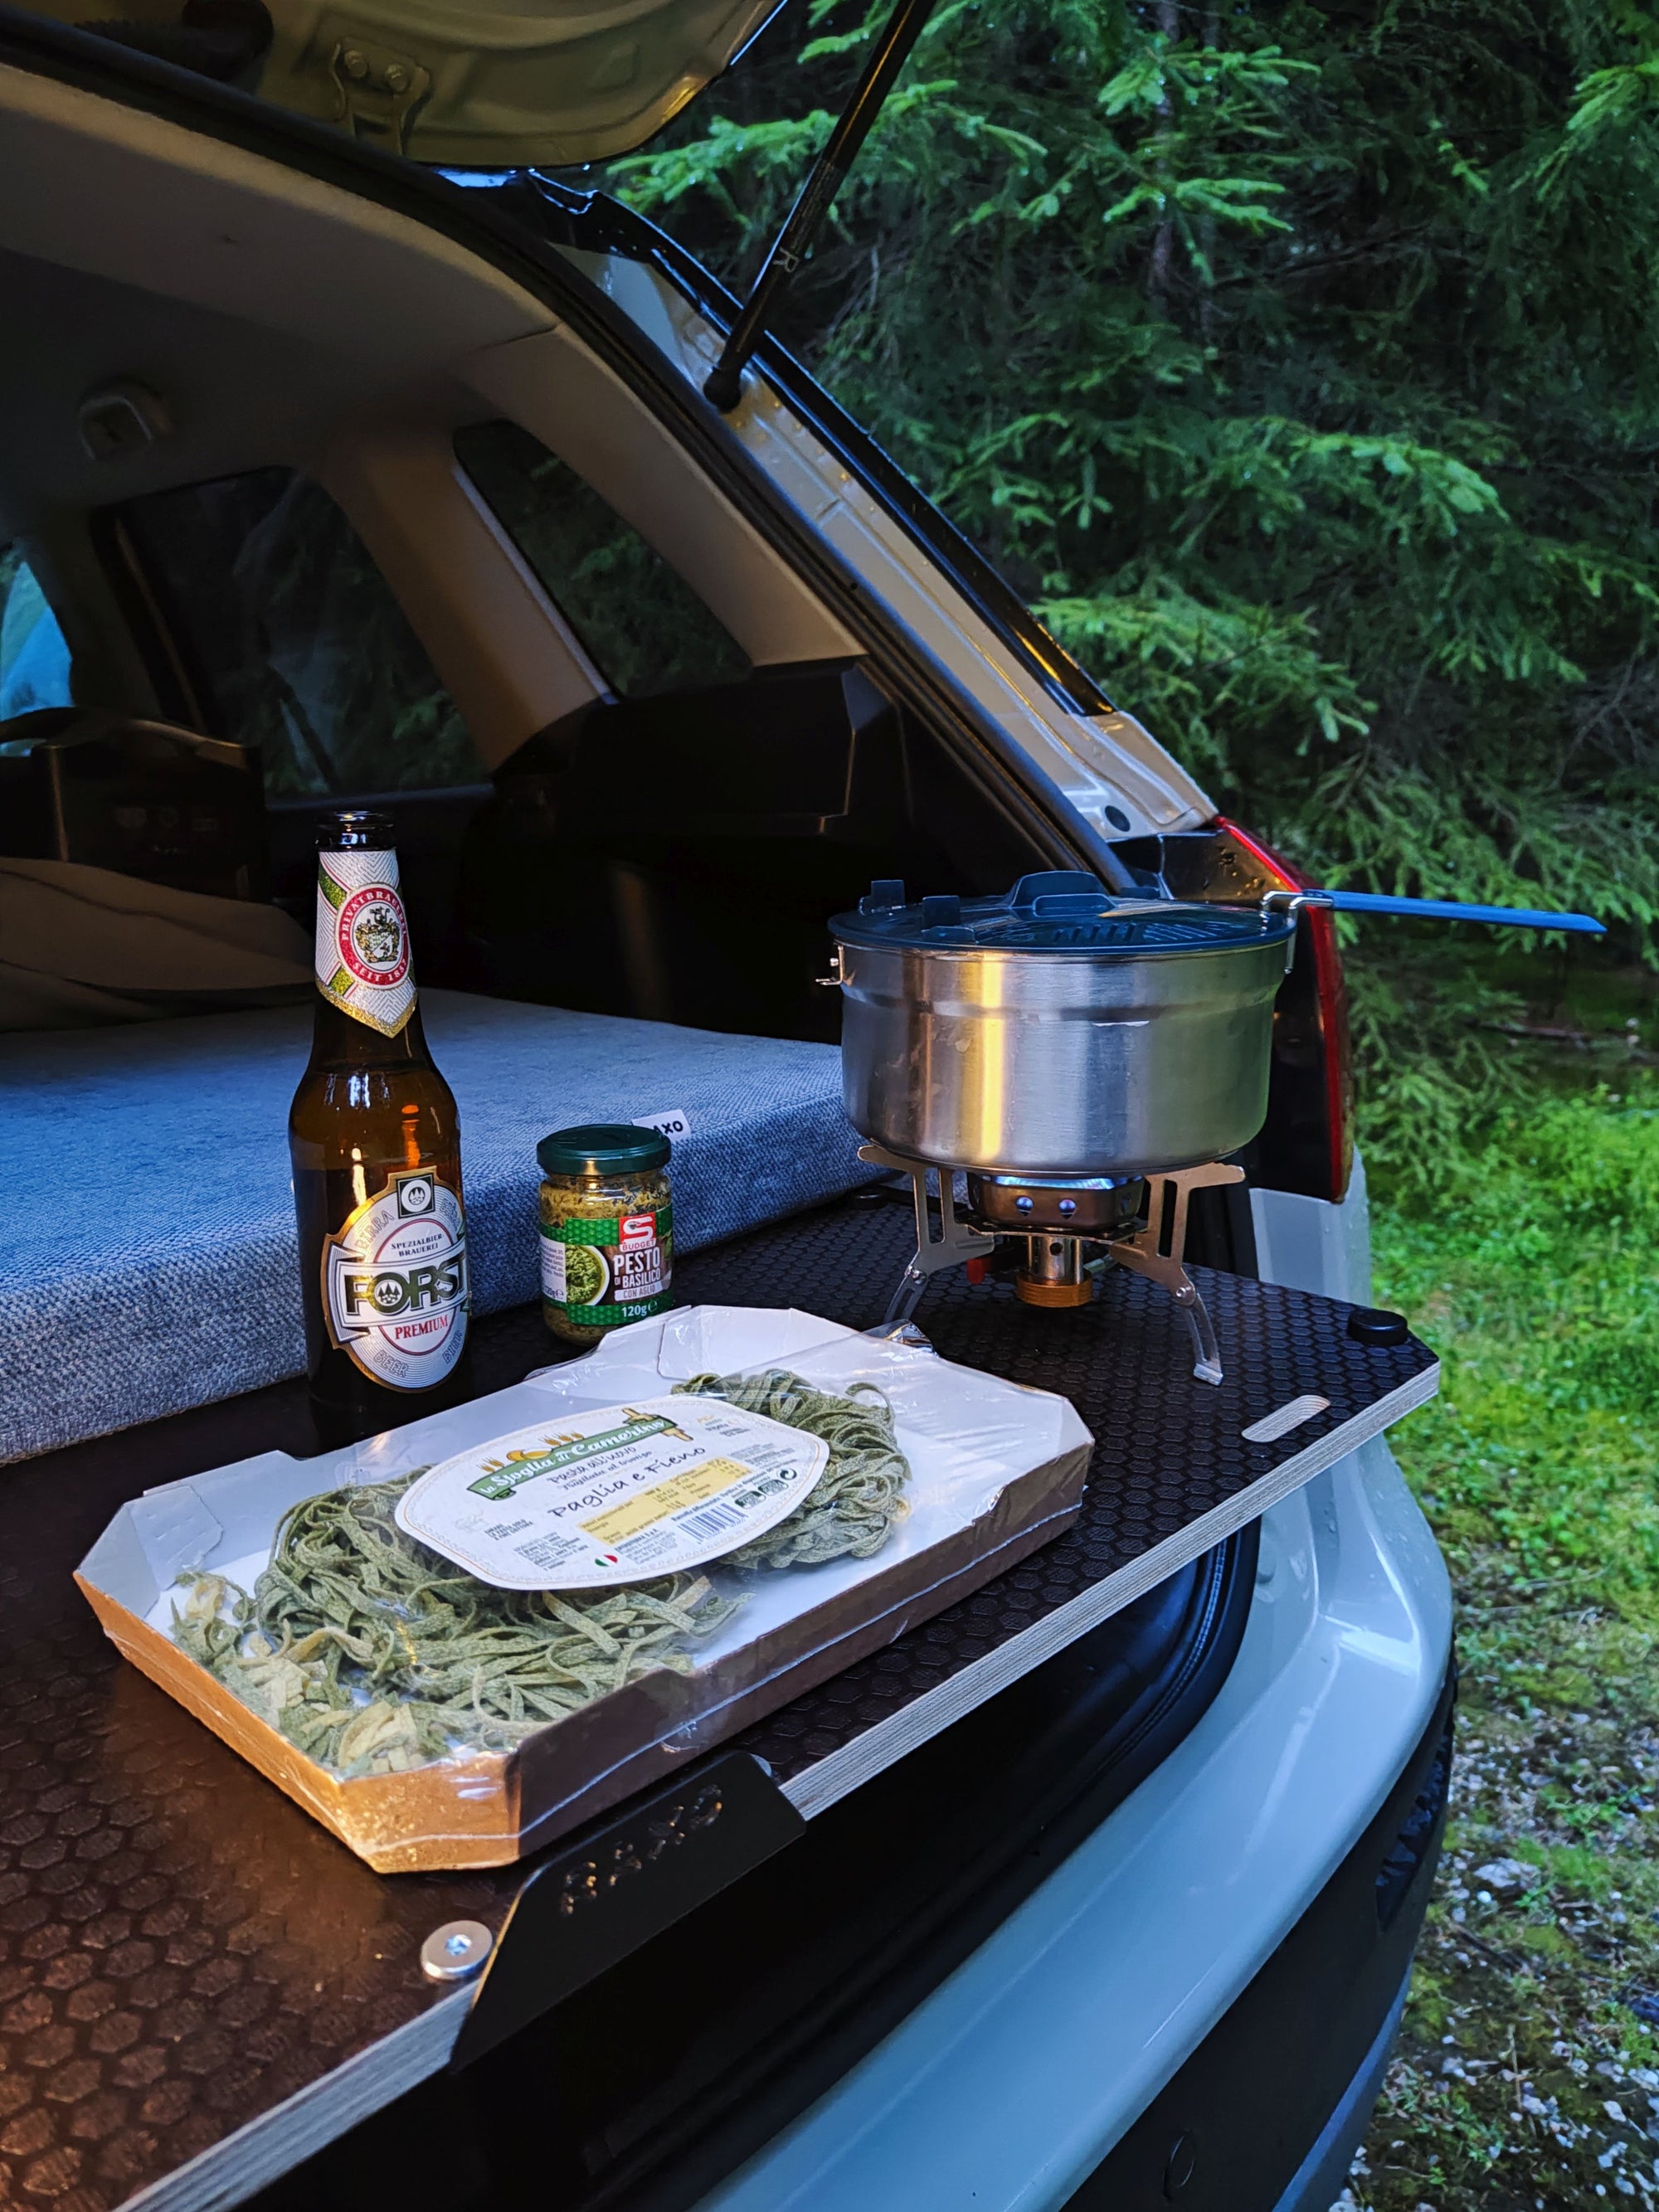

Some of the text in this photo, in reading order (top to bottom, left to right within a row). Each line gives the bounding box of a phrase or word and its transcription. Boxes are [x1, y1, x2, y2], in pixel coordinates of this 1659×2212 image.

[353, 962, 382, 981] SEIT
[355, 1209, 395, 1250] BIRRA
[398, 1242, 439, 1257] BRAUEREI
[621, 1239, 655, 1252] BUDGET
[613, 1247, 660, 1276] PESTO
[343, 1251, 466, 1317] FORST
[614, 1268, 661, 1288] DI BASILICO
[623, 1286, 656, 1299] CON AGLIO
[621, 1305, 647, 1318] 120g
[394, 1314, 449, 1340] PREMIUM
[374, 1349, 410, 1378] BEER
[571, 1420, 665, 1456] Camerino
[547, 1480, 629, 1518] Paglia
[632, 1472, 645, 1482] e
[644, 1447, 706, 1474] Fieno
